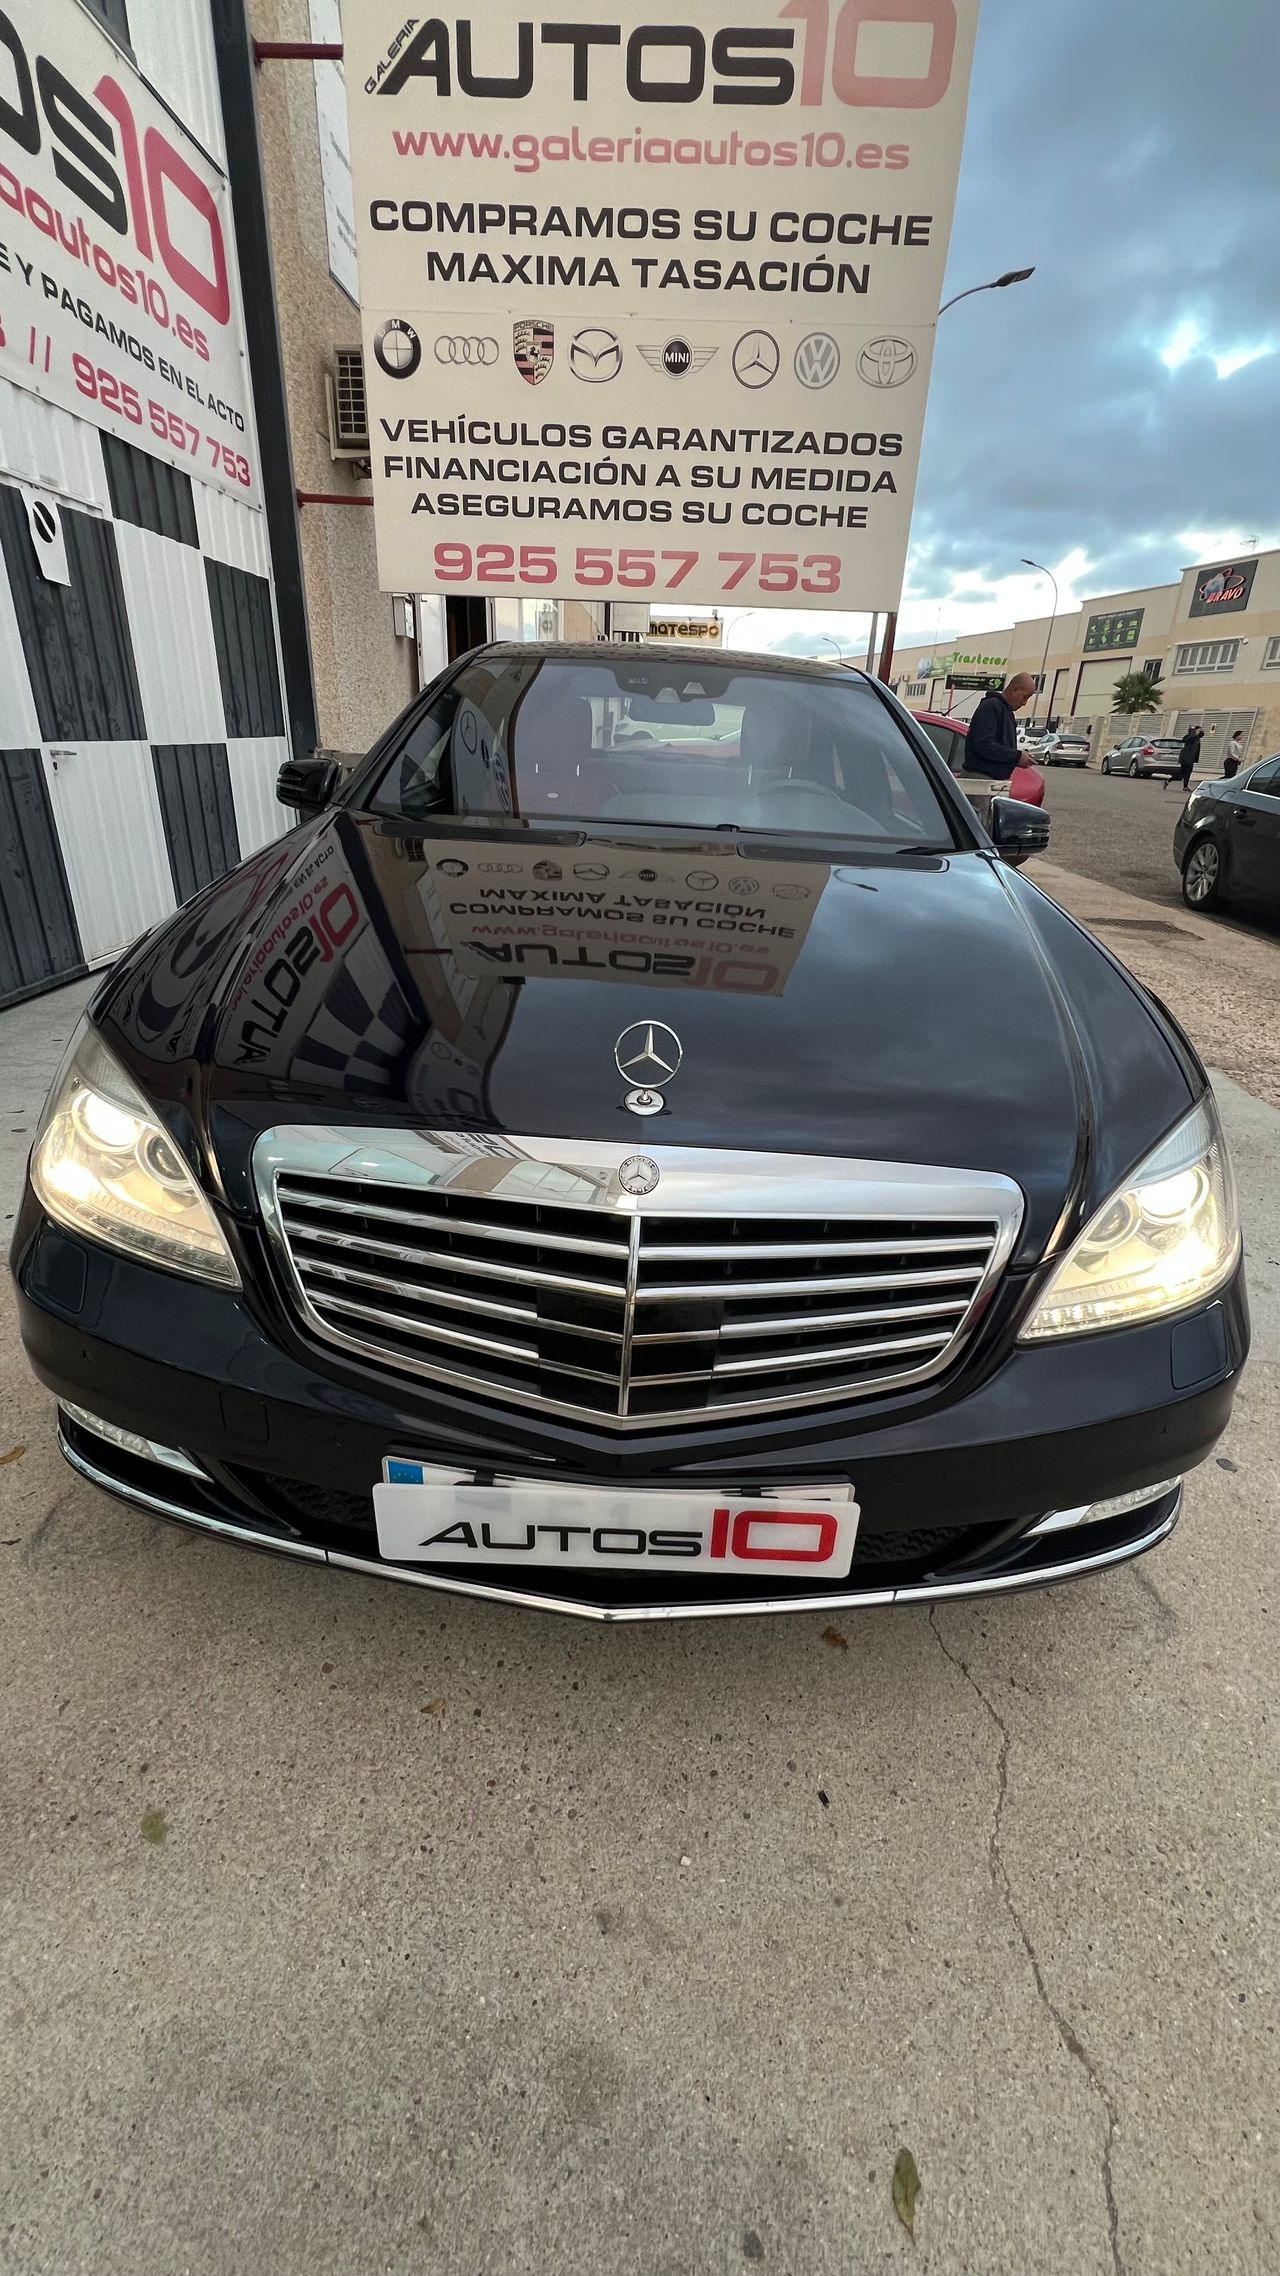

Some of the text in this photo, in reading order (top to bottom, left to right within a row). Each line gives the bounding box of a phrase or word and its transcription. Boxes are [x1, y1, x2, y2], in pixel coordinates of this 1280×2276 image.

[364, 19, 420, 95] GALERIA
[377, 0, 957, 109] AUTOS10
[392, 126, 910, 172] www.galeriaautos10.es
[370, 199, 681, 239] COMPRAMOS
[693, 209, 757, 242] SU
[770, 211, 933, 246] COCHE
[427, 251, 870, 294] MAXIMA TASACIÓN
[15, 252, 34, 286] Y
[41, 272, 156, 371] PAGAMOS
[158, 356, 184, 391] EN
[185, 375, 205, 405] EL
[207, 392, 245, 432] ACTO
[664, 351, 690, 364] MINI
[72, 352, 143, 425] 925
[148, 399, 200, 456] 557
[206, 436, 251, 487] 753
[380, 414, 903, 457] VEHÍCULOS GARANTIZADOS
[384, 455, 898, 493] FINANCIACIÓN A SU MEDIDA
[411, 492, 869, 528] ASEGURAMOS SU COCHE
[434, 542, 842, 594] 925 557 753
[1206, 586, 1244, 604] BRAVO
[418, 1508, 838, 1563] AUTOS10
